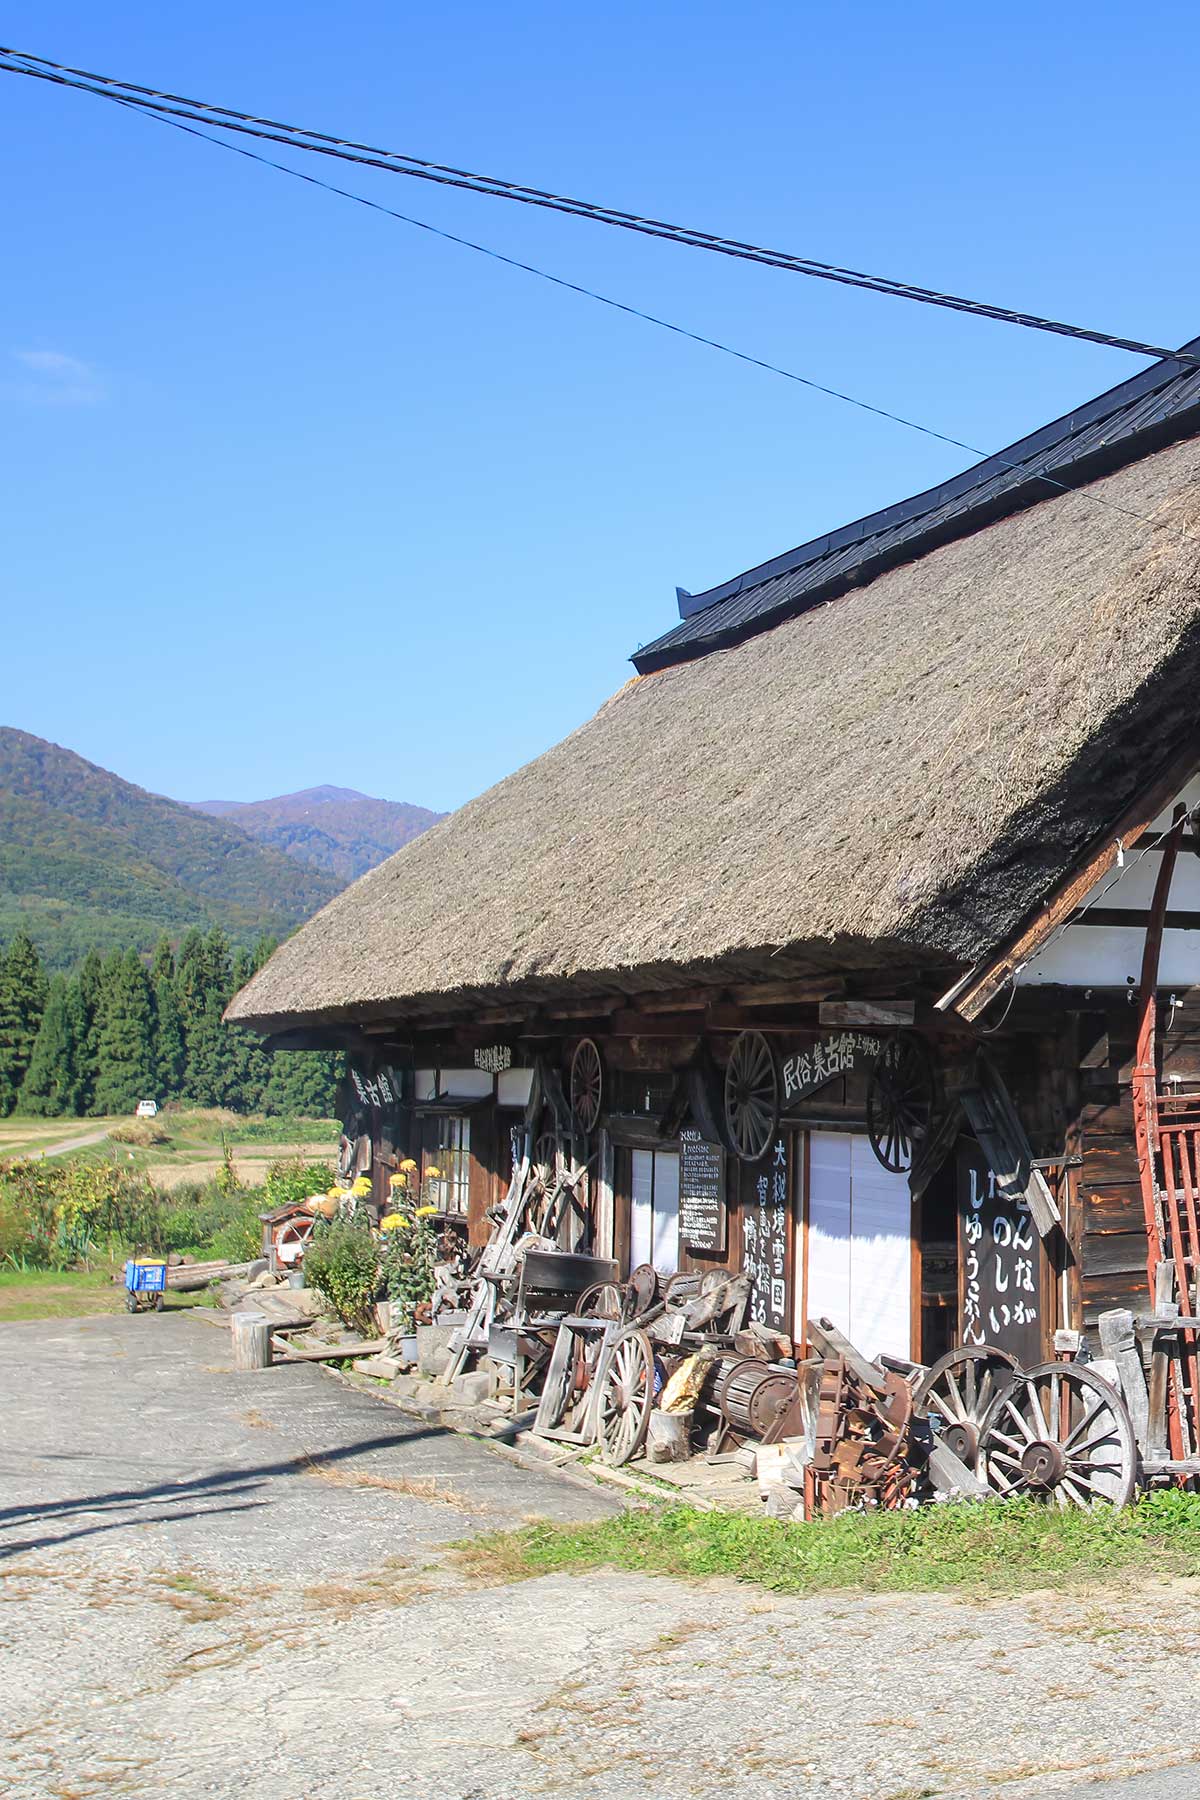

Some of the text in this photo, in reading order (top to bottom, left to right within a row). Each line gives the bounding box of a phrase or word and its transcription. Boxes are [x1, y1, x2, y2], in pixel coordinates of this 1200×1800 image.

[783, 1032, 855, 1099] 民俗集古館
[1012, 1199, 1037, 1325] んなが
